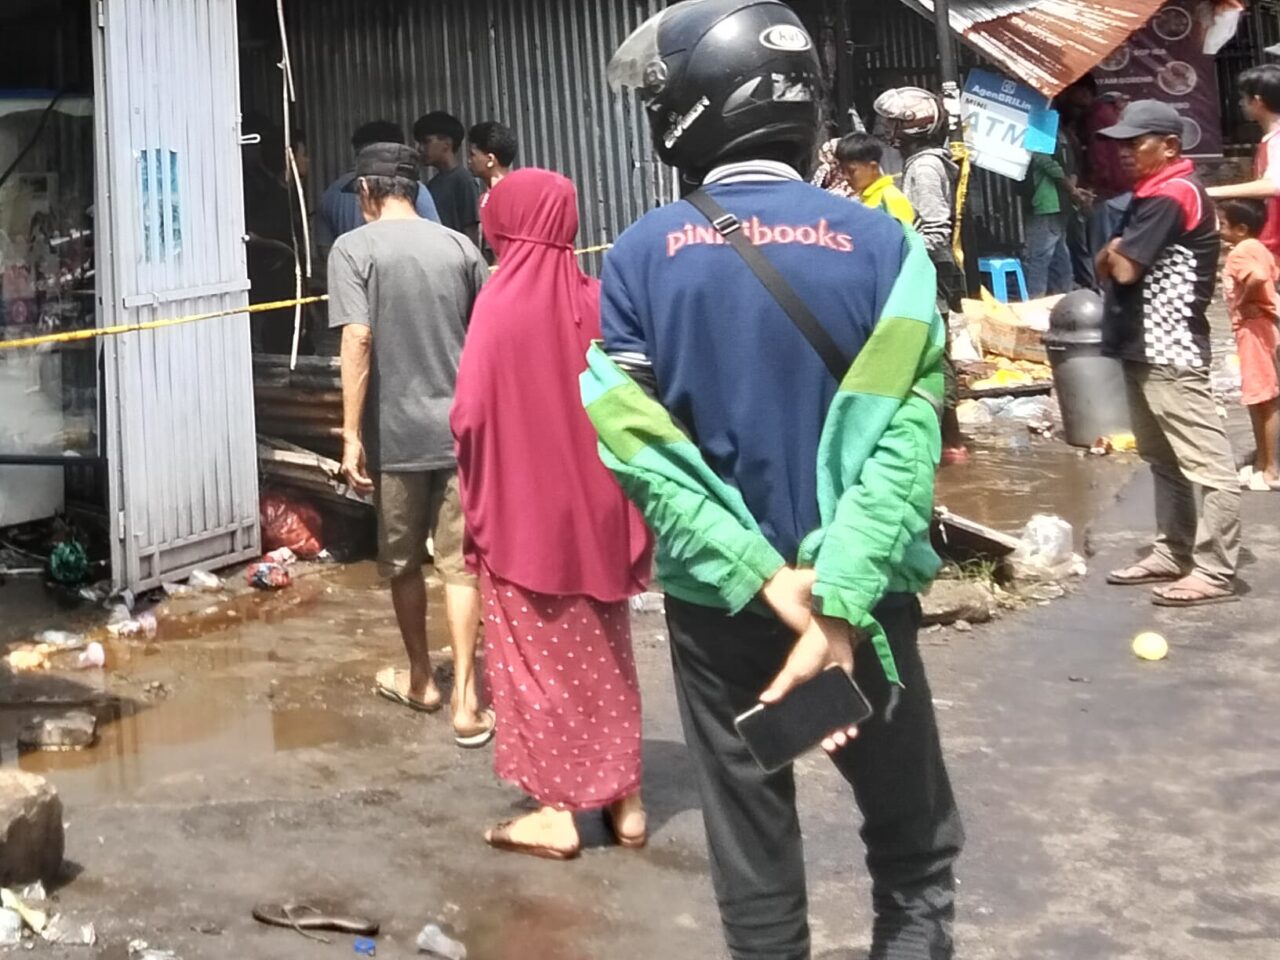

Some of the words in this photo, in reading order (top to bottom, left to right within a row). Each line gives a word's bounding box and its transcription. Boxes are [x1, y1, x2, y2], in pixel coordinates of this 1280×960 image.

[964, 97, 987, 110] MINI
[971, 84, 1032, 110] AgenBRILin
[962, 111, 1029, 149] ATM
